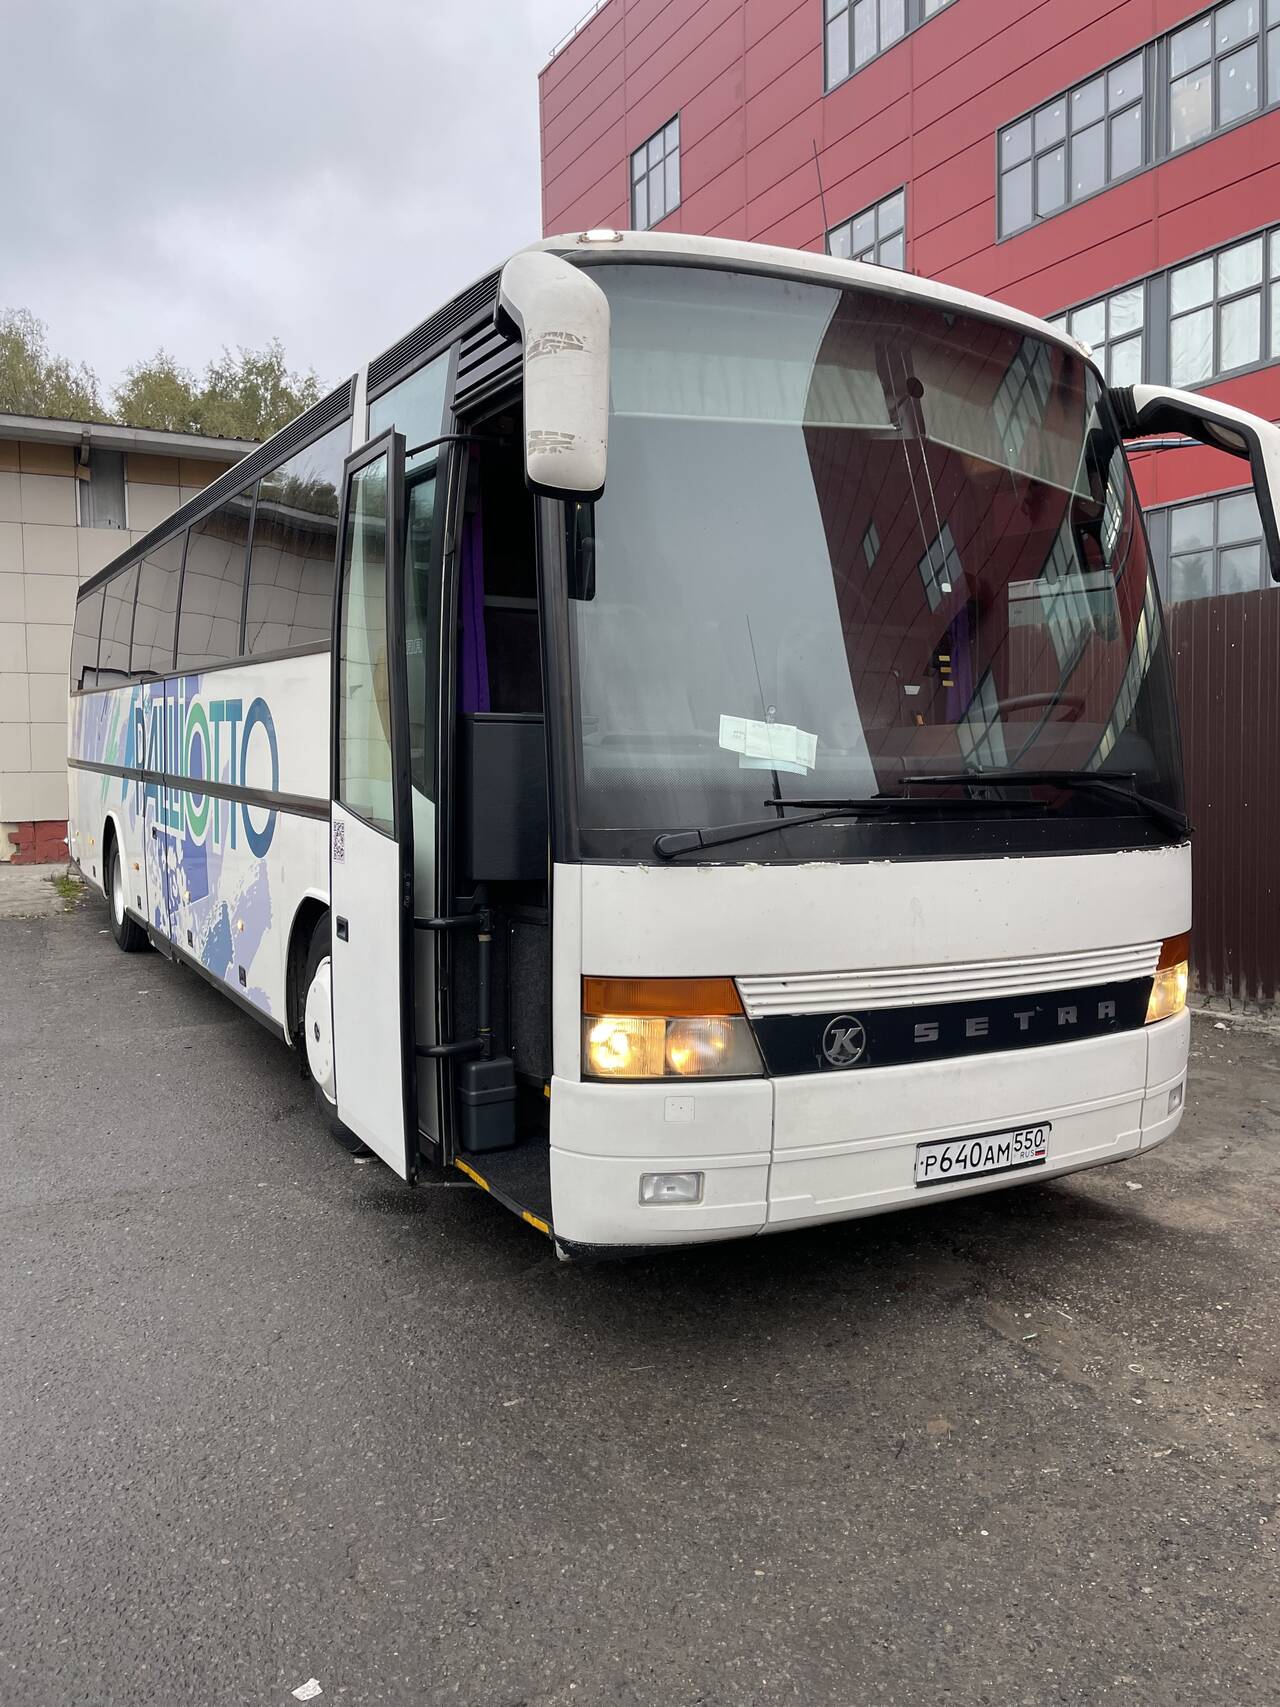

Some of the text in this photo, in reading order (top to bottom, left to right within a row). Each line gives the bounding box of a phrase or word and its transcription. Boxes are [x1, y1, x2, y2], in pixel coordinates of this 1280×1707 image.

[914, 1000, 1116, 1043] SETRA
[1013, 1129, 1043, 1152] 550
[1020, 1150, 1035, 1159] RUS
